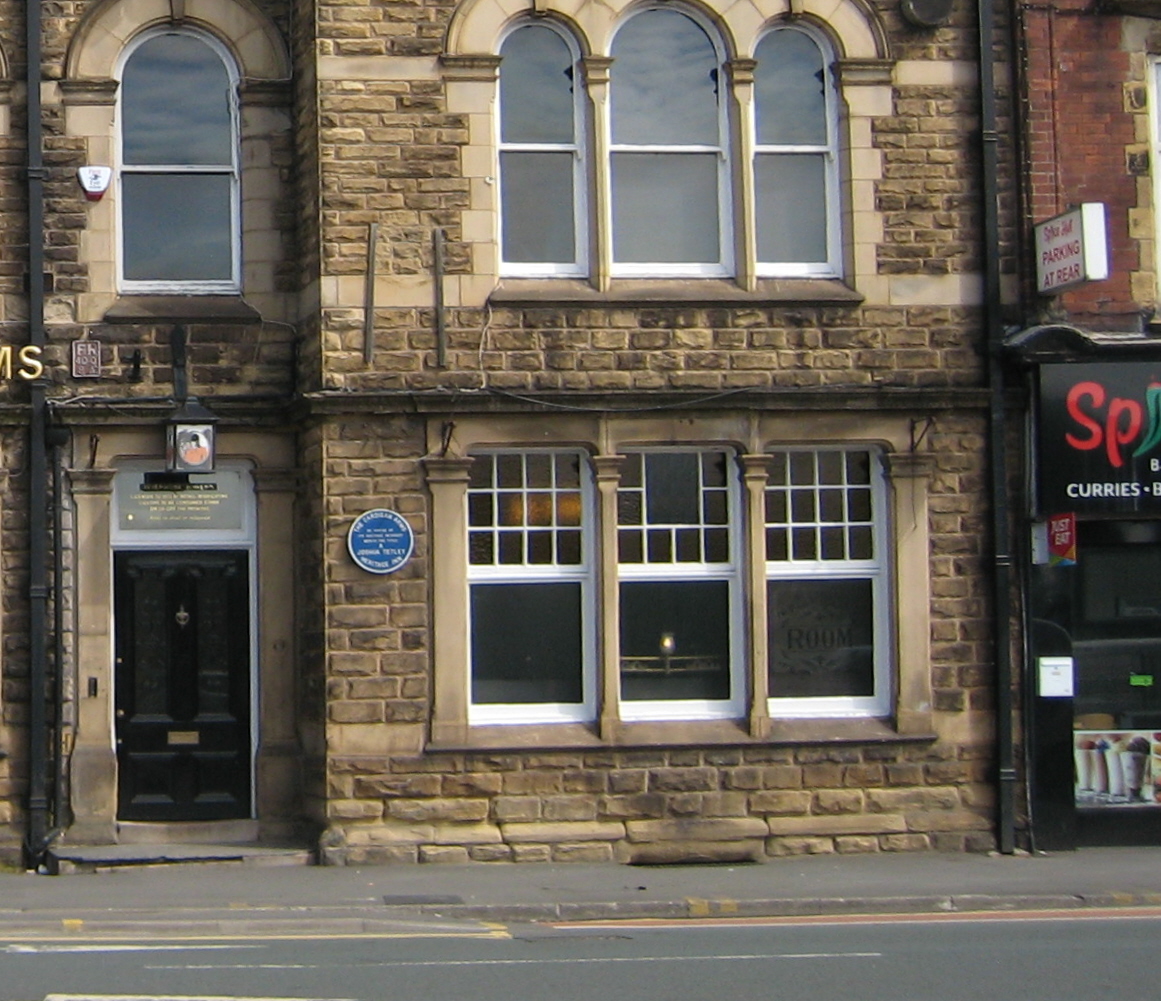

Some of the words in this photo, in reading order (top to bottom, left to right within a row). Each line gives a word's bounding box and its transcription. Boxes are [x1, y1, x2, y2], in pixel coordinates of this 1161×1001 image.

[1042, 240, 1080, 266] PARKING
[1043, 272, 1054, 288] AT
[1055, 263, 1080, 283] REAR
[1067, 482, 1140, 498] CURRIES
[1051, 518, 1070, 534] JUST
[1055, 532, 1071, 545] EAT
[787, 628, 853, 650] ROOM
